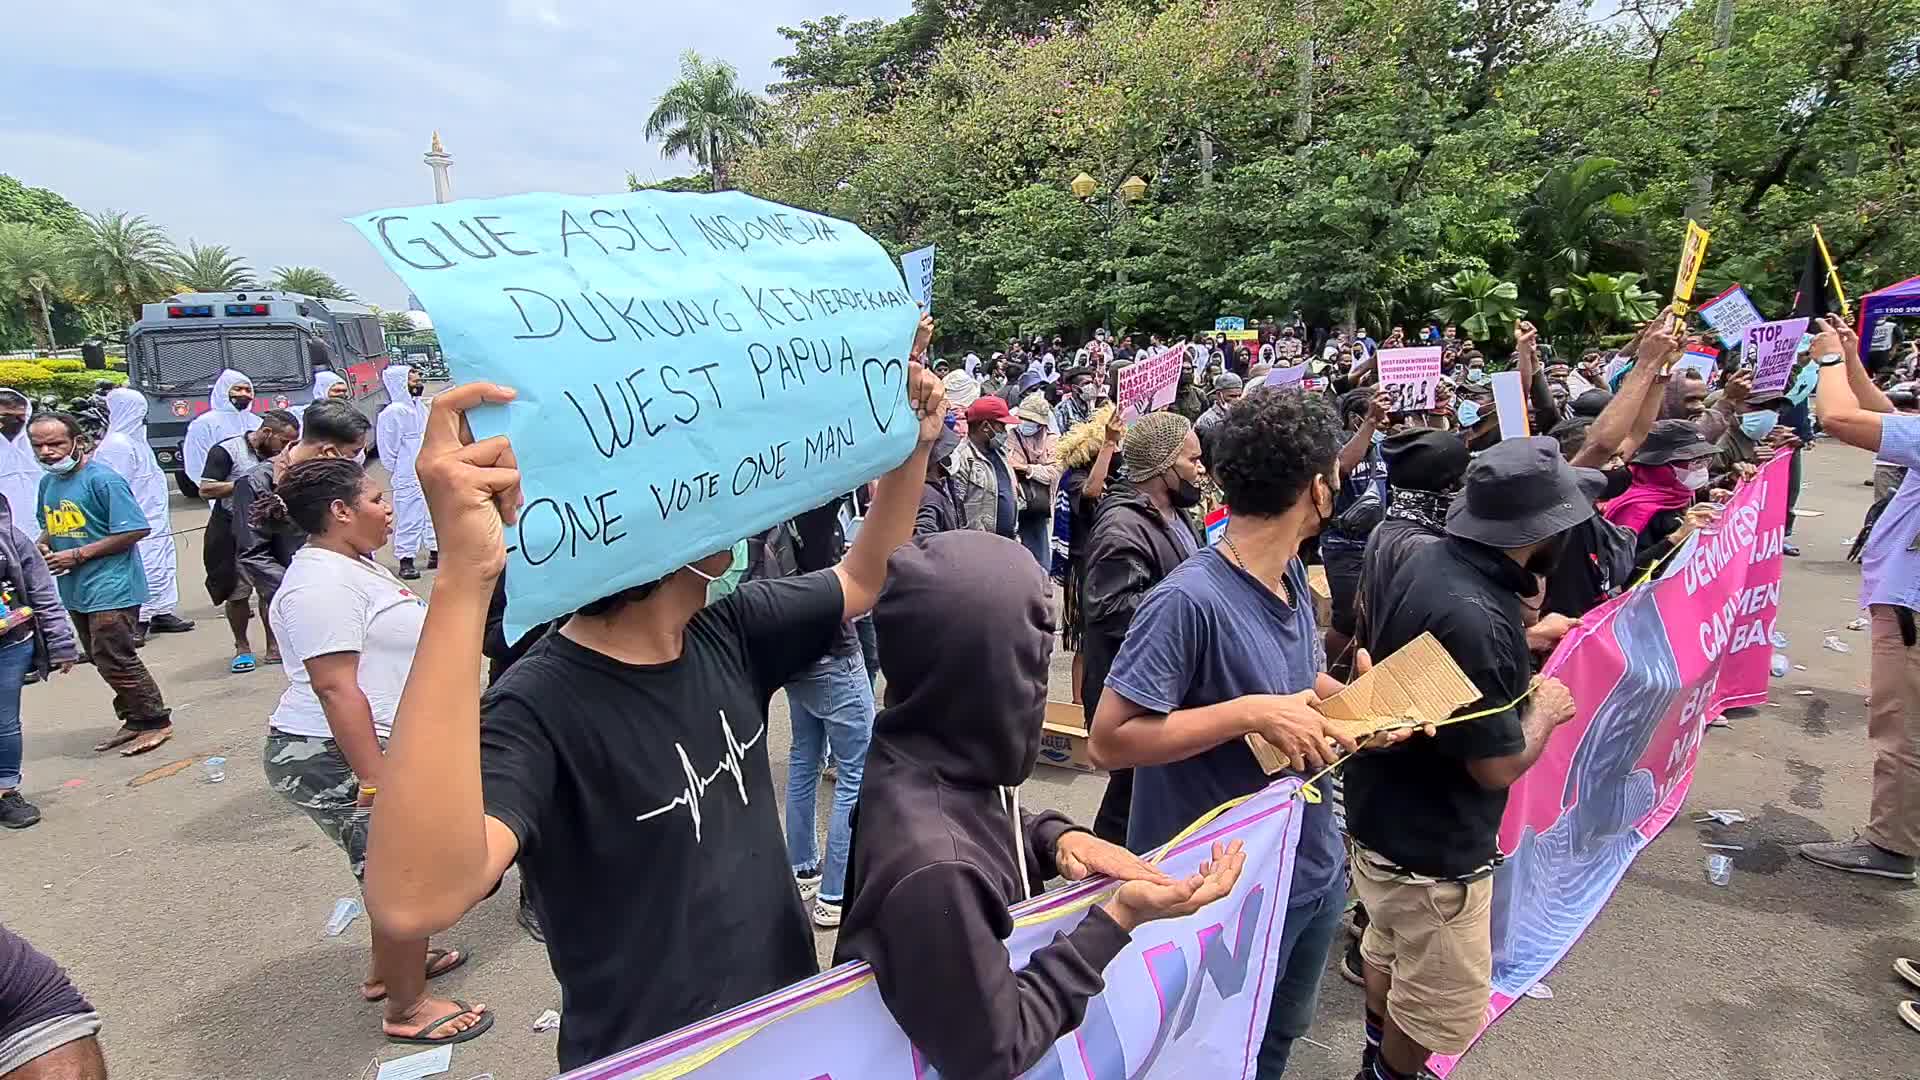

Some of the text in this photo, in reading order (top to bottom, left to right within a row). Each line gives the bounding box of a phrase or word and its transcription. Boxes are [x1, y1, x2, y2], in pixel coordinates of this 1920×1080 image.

[369, 214, 540, 269] GUE
[561, 208, 686, 257] ASLI
[502, 284, 910, 343] DUKUNG KEMERDEKAAN
[1750, 325, 1782, 343] STOP
[564, 335, 860, 460] WEST PAPUA
[1120, 366, 1137, 380] HAK
[650, 472, 721, 521] VOTE
[732, 441, 791, 495] ONE
[804, 417, 856, 469] MAN
